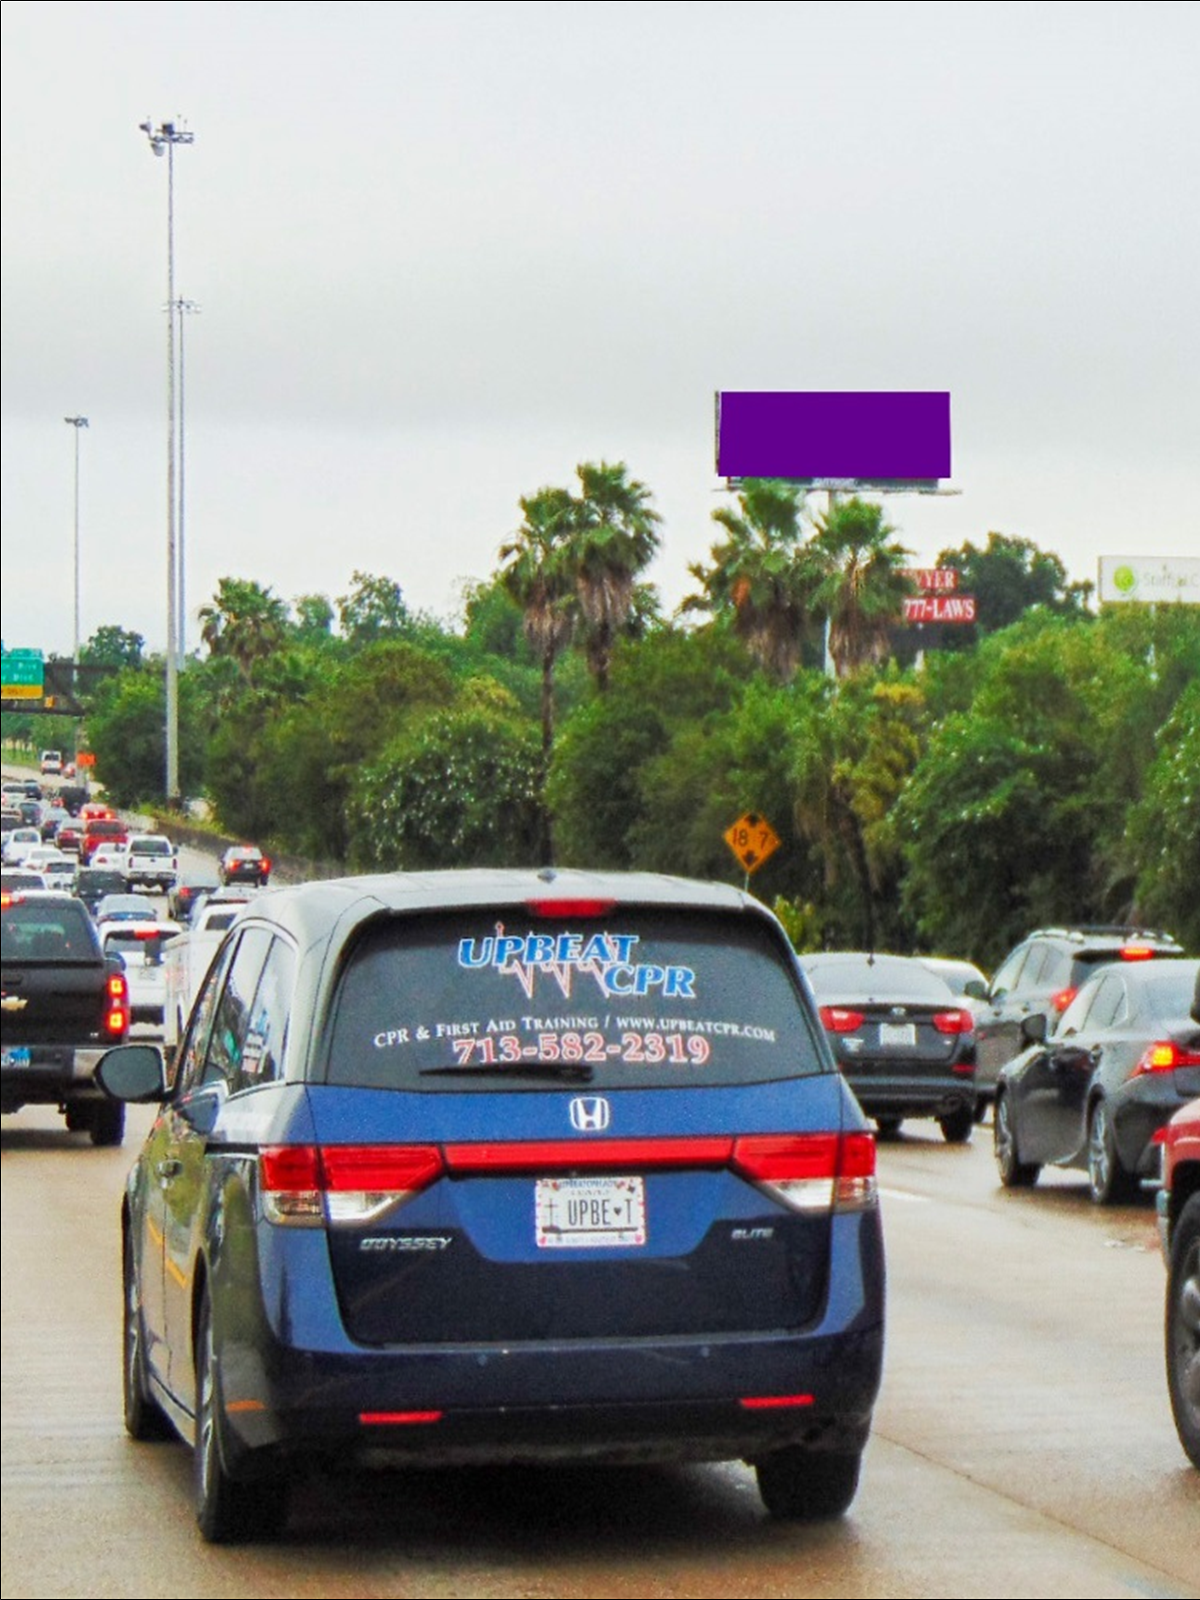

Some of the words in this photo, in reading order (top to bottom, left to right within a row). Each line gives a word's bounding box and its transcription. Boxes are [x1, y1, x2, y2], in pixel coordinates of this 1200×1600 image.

[458, 934, 639, 968] UPBEAT
[603, 964, 696, 998] CPR
[373, 1028, 410, 1048] CPR
[415, 1026, 431, 1042] &
[435, 1022, 480, 1038] FIRST
[486, 1018, 516, 1033] AID
[521, 1015, 598, 1030] TRAINING
[452, 1032, 711, 1065] 713-582-2319
[359, 1237, 453, 1251] ODYSSEY
